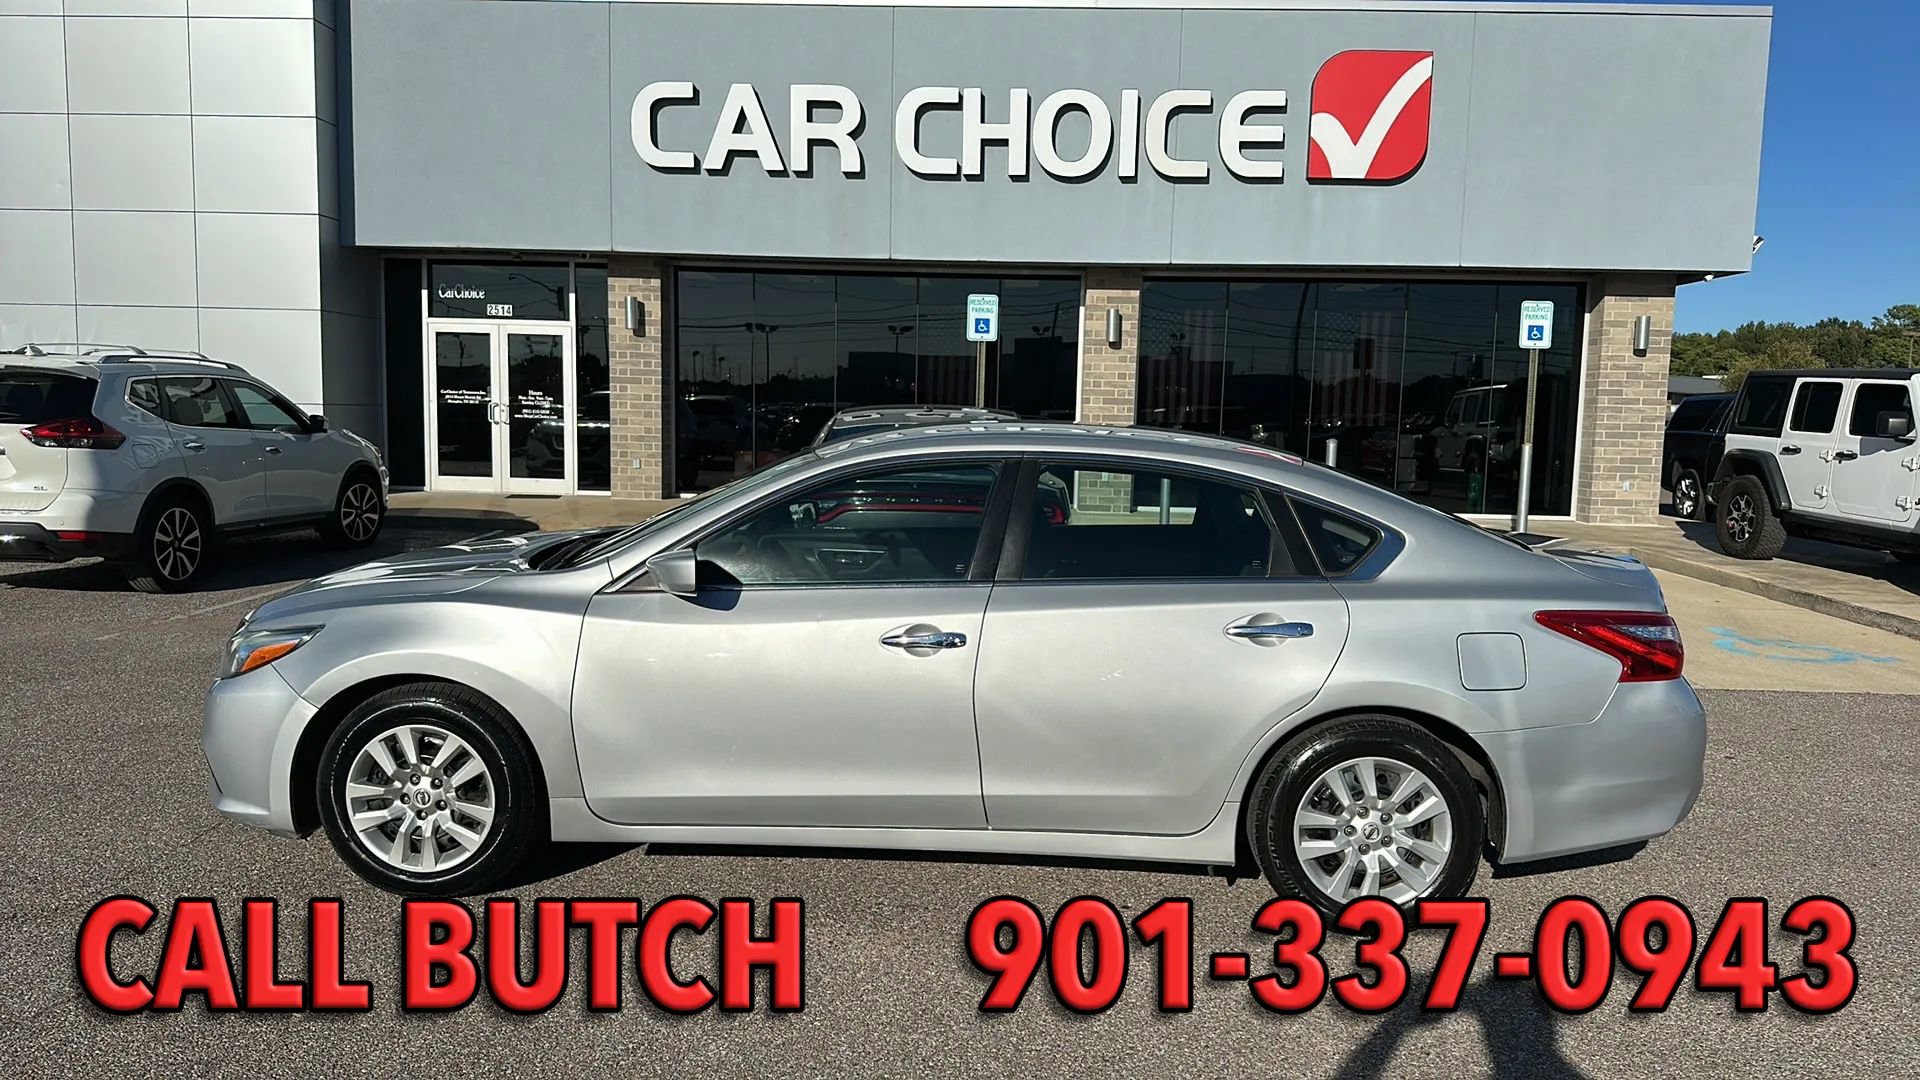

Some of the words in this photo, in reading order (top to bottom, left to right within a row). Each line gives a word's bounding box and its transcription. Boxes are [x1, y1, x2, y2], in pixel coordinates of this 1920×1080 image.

[630, 82, 865, 177] CAR
[895, 87, 1288, 180] CHOICE
[438, 284, 486, 299] CarChoice
[488, 305, 512, 315] 2514
[1523, 305, 1551, 313] RESERVED
[1525, 313, 1549, 321] PARKING
